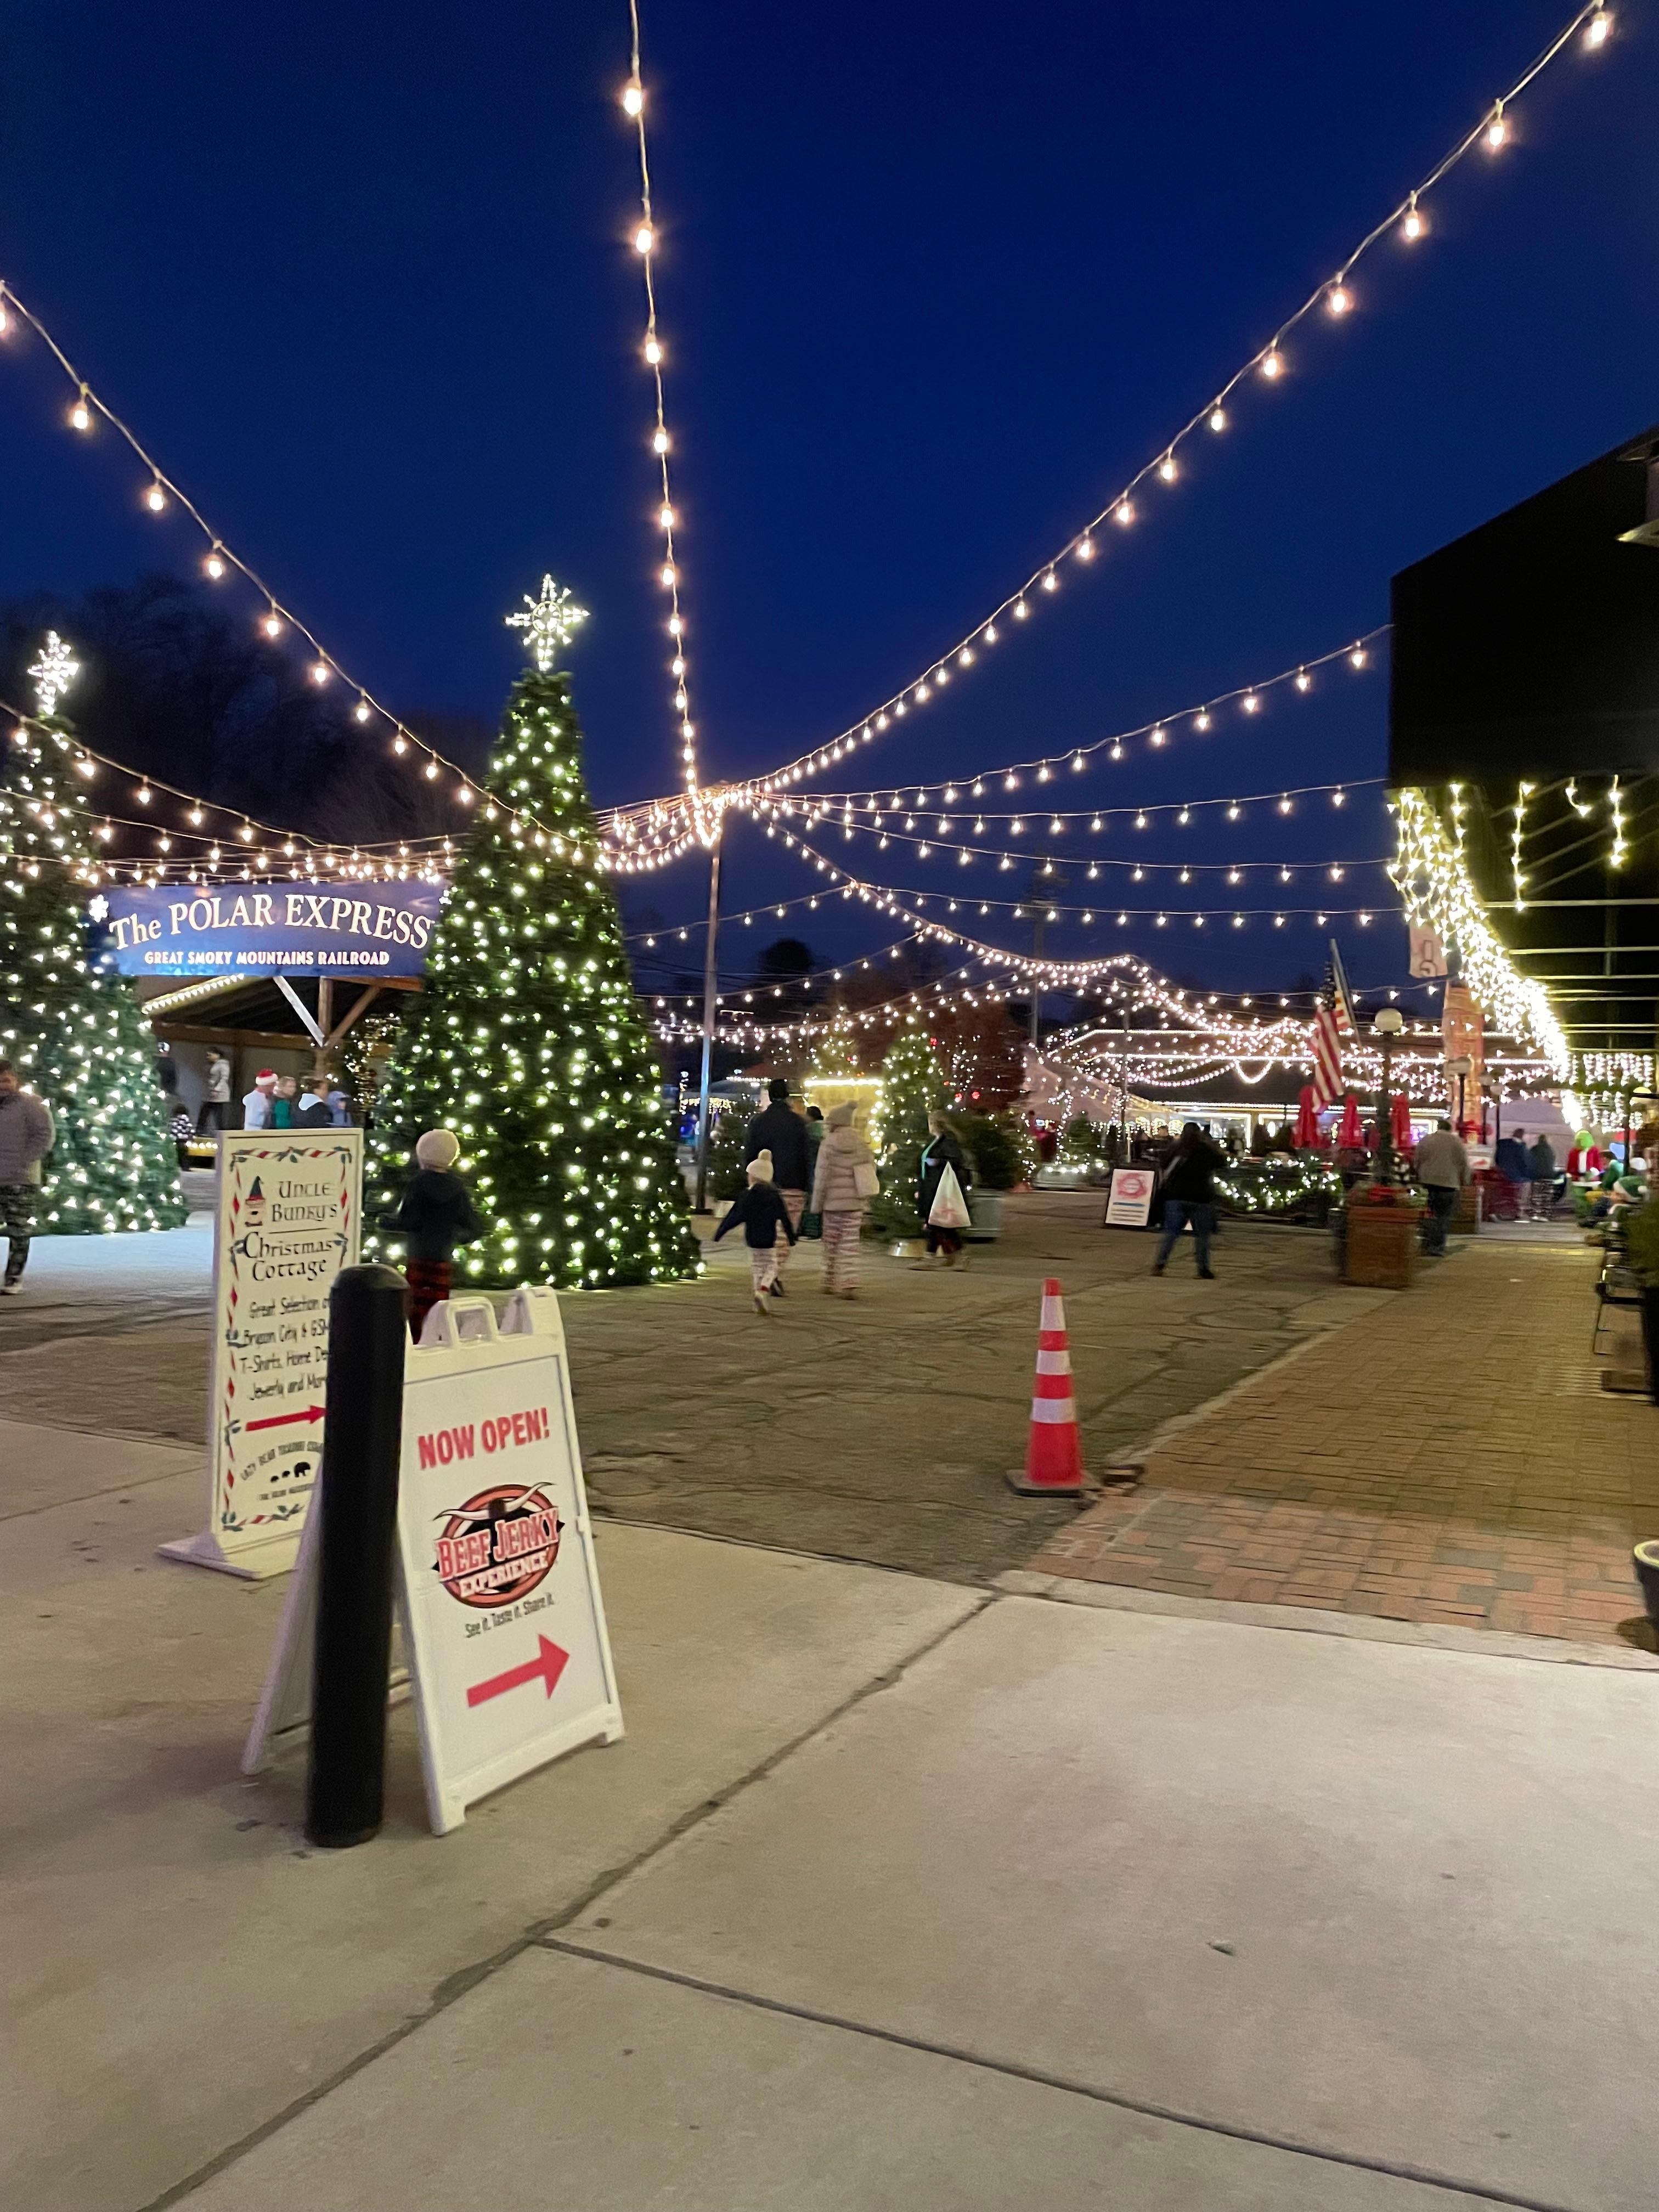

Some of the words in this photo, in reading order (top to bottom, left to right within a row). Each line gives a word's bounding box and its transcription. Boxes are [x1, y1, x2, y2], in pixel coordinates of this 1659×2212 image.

[109, 913, 161, 950] The
[168, 894, 275, 935] POLAR
[284, 893, 436, 949] EXPRESS
[144, 951, 183, 965] GREAT
[188, 951, 233, 965] SMOKY
[236, 951, 314, 966] MOUNTAINS
[318, 951, 390, 966] RAILROAD
[245, 1231, 332, 1258] Christmas
[252, 1260, 326, 1281] Cottage
[250, 1298, 275, 1318] Great
[279, 1295, 320, 1314] Selection
[286, 1351, 311, 1367] Home
[287, 1373, 304, 1393] and
[417, 1424, 475, 1470] NOW
[481, 1407, 550, 1453] OPEN!
[437, 1530, 490, 1581] BEEF
[494, 1508, 558, 1561] JERKY
[459, 1550, 549, 1597] EXPERIENCE
[465, 1623, 481, 1638] See
[490, 1610, 513, 1627] Taste
[523, 1597, 546, 1615] Share
